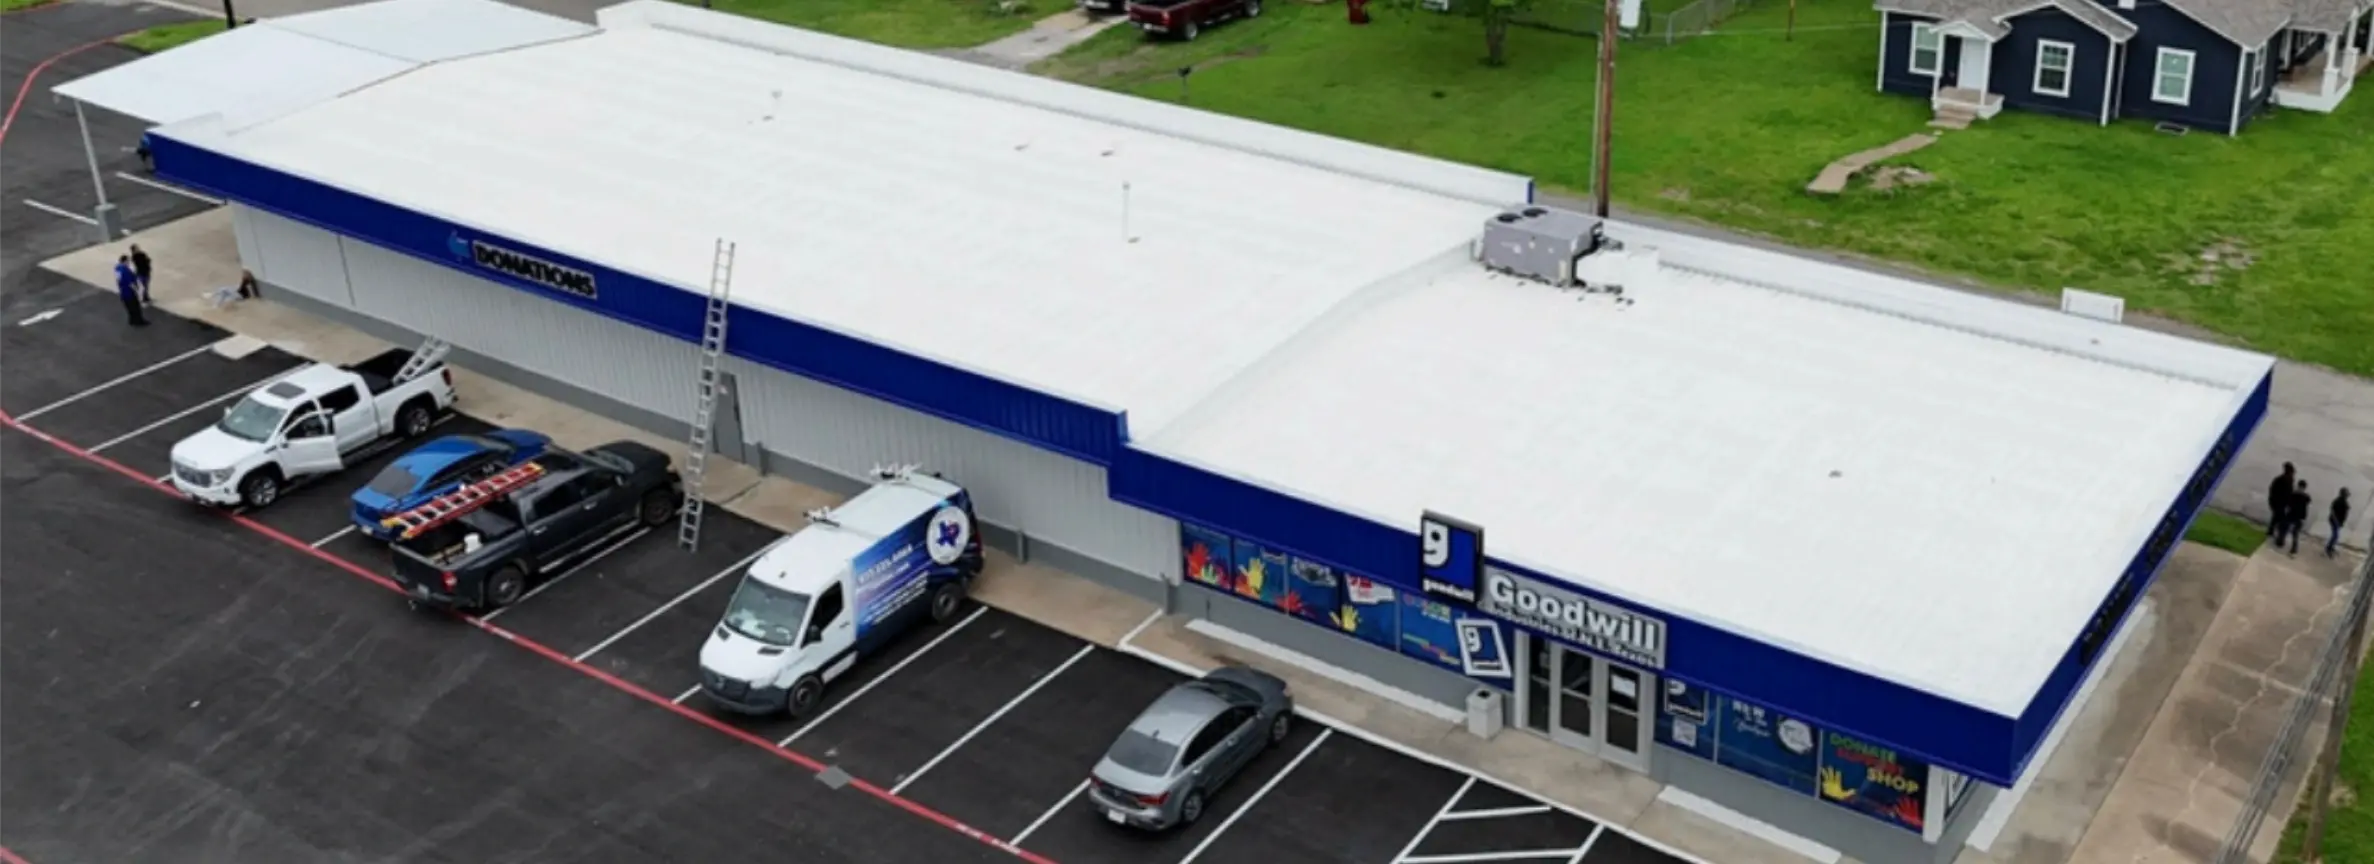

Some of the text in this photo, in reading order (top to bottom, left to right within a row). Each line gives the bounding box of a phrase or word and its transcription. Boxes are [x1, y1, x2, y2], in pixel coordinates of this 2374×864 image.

[474, 242, 595, 297] DONATIONS
[1488, 574, 1657, 650] Goodwill
[1829, 732, 1897, 762] DONATE
[1866, 767, 1920, 794] SHOP
